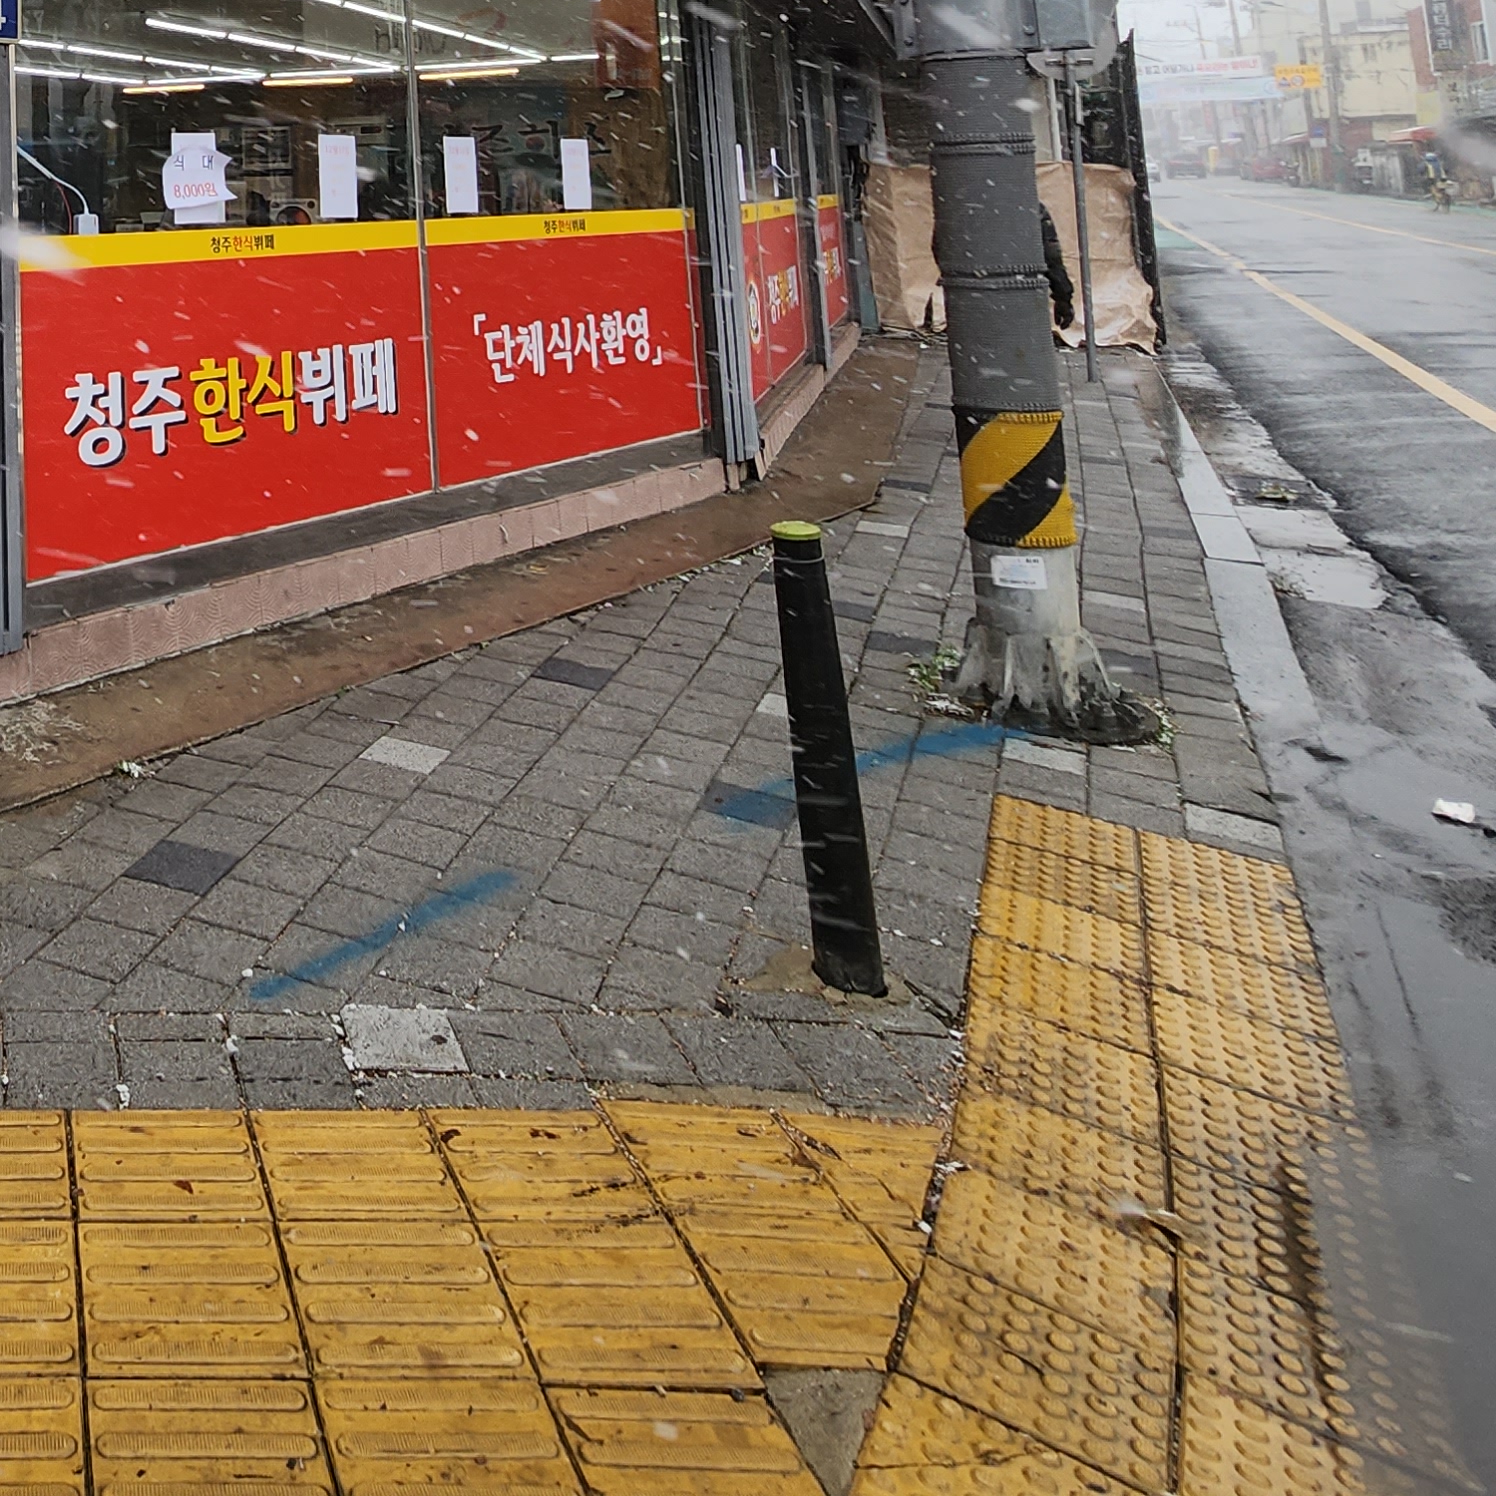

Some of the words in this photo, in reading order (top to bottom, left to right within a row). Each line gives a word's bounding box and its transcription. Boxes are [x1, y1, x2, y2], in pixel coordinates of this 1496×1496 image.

[173, 182, 219, 200] 8,000원
[210, 233, 275, 254] 청주한식뷔페
[62, 336, 399, 469] 청주한식뷔페
